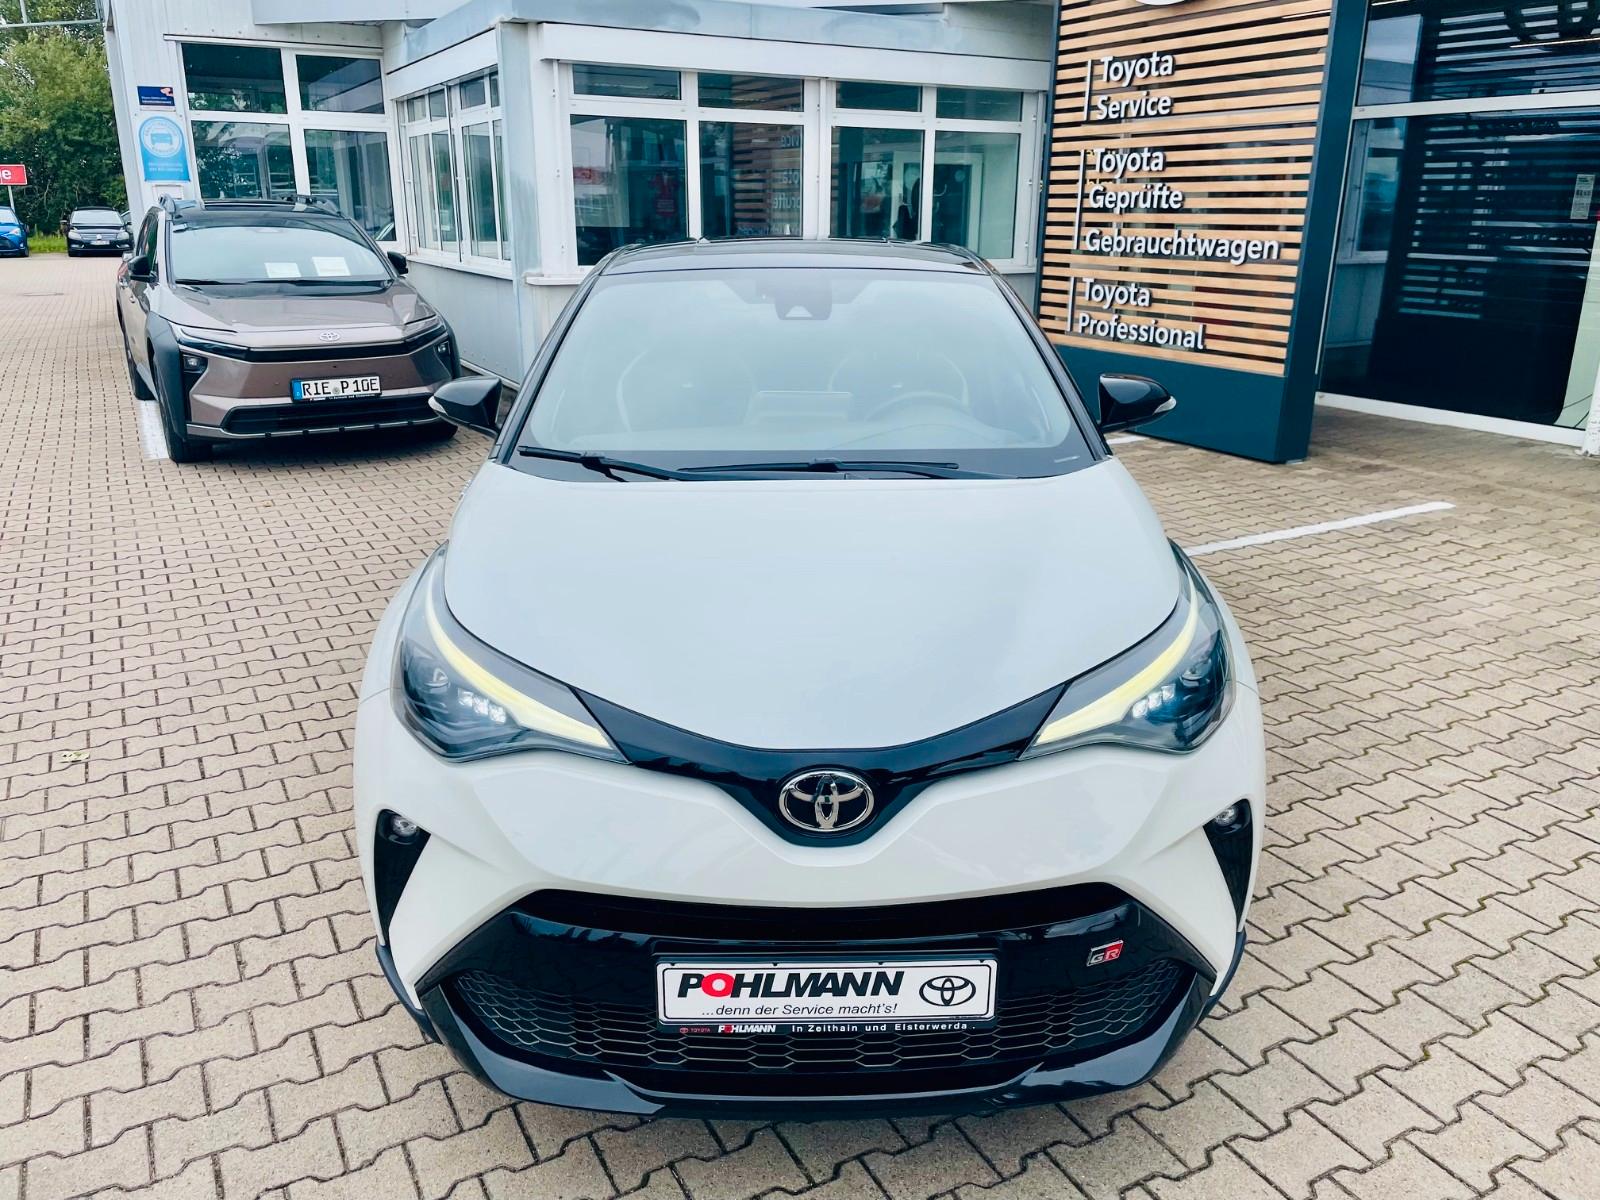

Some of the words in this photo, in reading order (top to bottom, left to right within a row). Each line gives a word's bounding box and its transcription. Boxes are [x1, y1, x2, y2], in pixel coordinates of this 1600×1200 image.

[1101, 51, 1174, 87] Toyota
[1097, 91, 1172, 119] Service
[0, 169, 12, 180] e
[1093, 148, 1164, 179] Toyota
[1089, 183, 1184, 214] Geprüfte
[1085, 228, 1280, 266] Gebrauchtwagen
[1082, 278, 1151, 309] Toyota
[1078, 312, 1205, 349] Professional
[302, 381, 331, 396] RIE
[340, 380, 349, 393] P
[1089, 946, 1121, 965] GR
[678, 971, 904, 998] POHLMANN
[755, 1005, 779, 1016] der
[782, 1004, 834, 1015] Service
[838, 1003, 898, 1014] macht's!
[718, 1024, 776, 1033] POHLMANN
[808, 1024, 858, 1033] Zeithain
